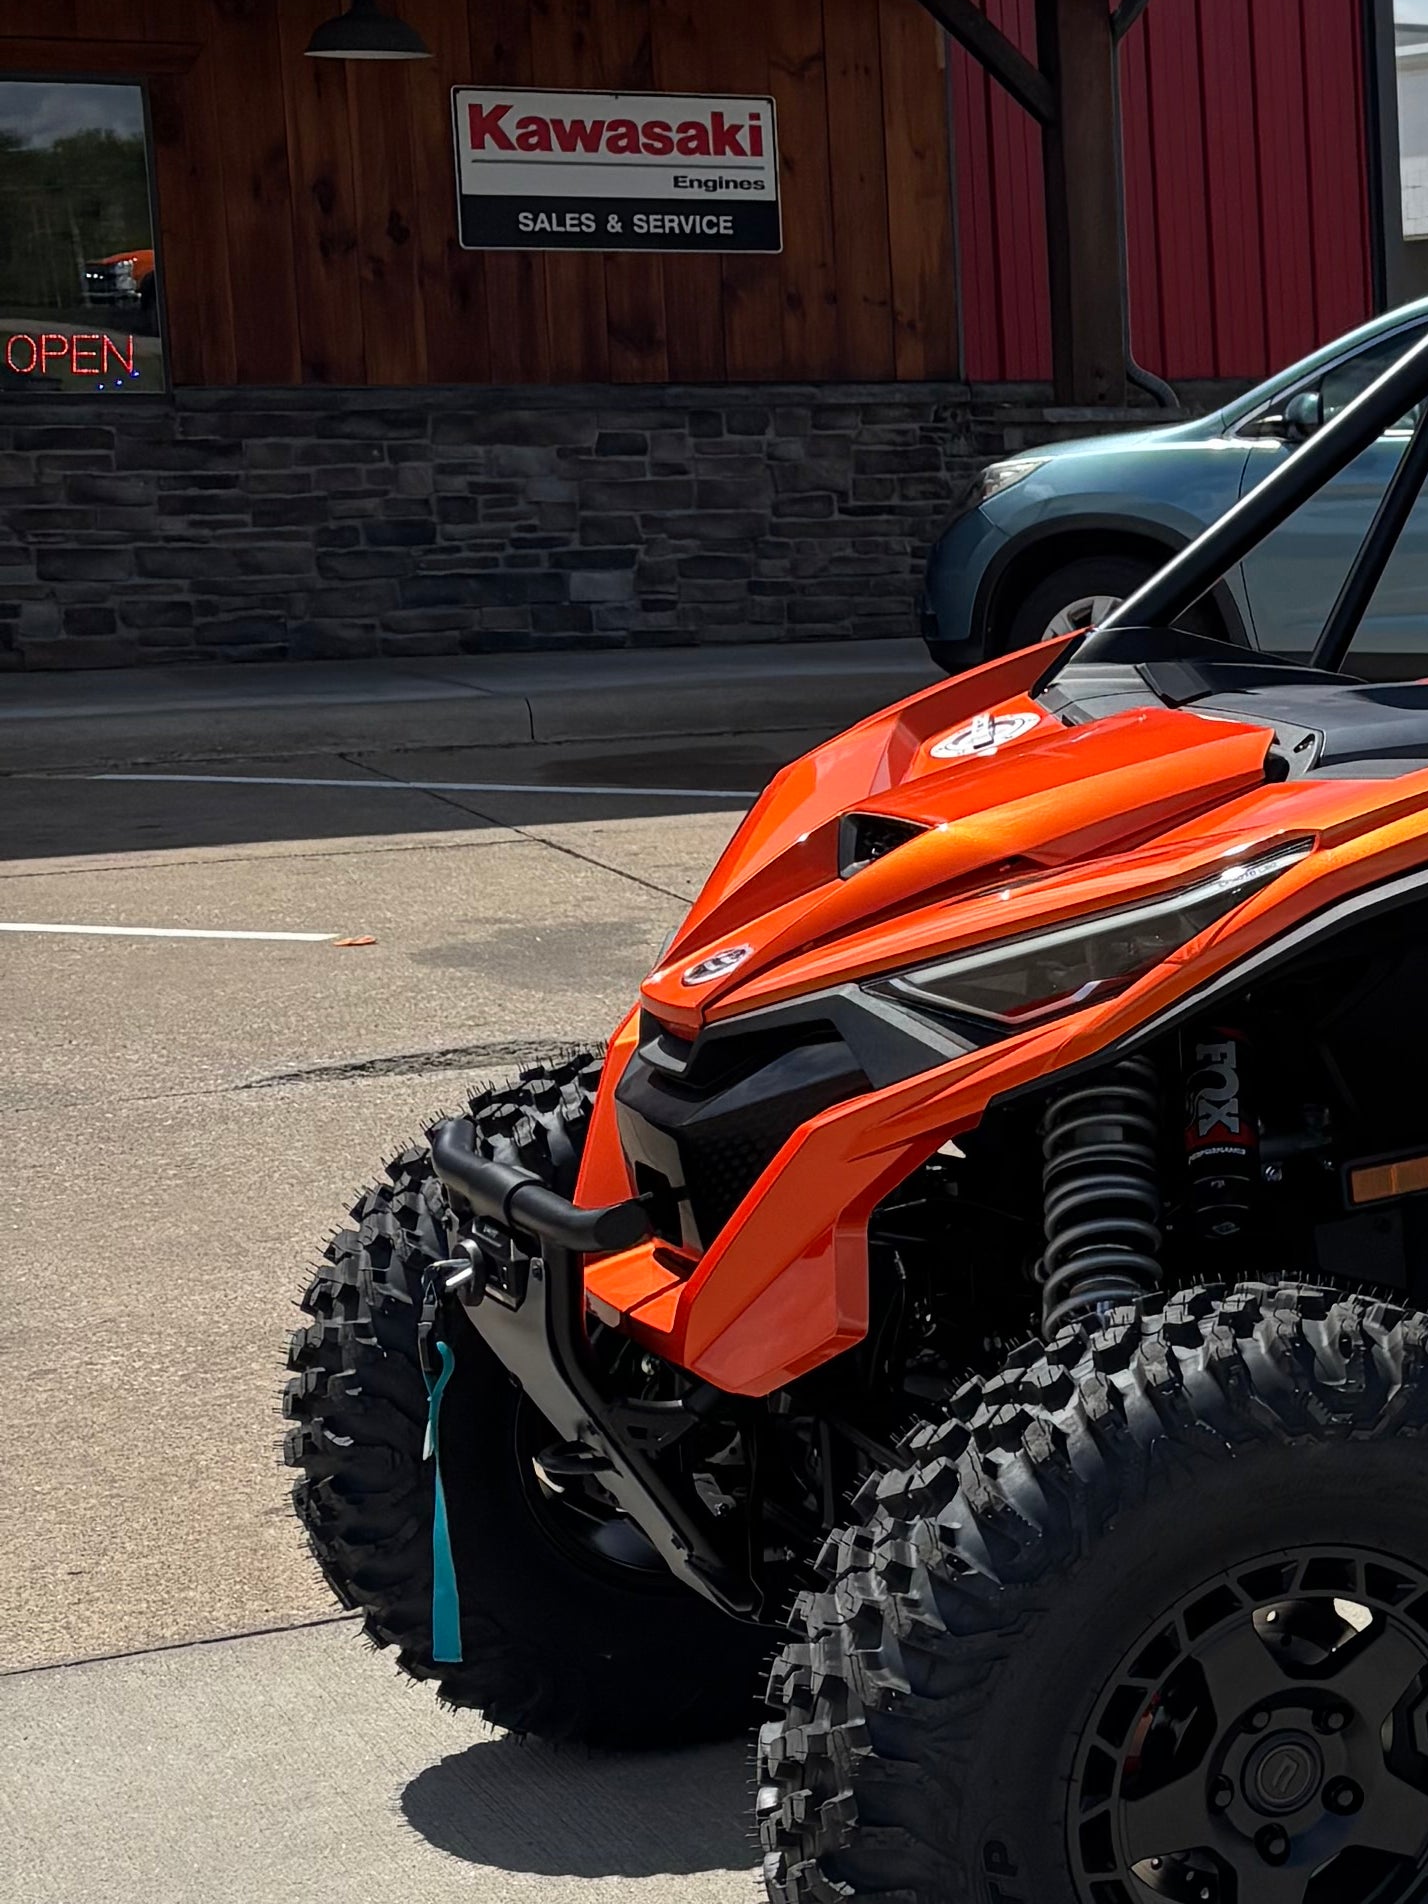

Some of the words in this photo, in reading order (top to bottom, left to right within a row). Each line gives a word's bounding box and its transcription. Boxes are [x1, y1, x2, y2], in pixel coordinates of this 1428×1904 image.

[468, 103, 764, 158] Kawasaki
[672, 175, 766, 193] Engines
[518, 212, 596, 234] SALES
[607, 213, 623, 234] &
[632, 213, 734, 236] SERVICE
[6, 334, 134, 374] OPEN
[1192, 1040, 1240, 1136] FOX
